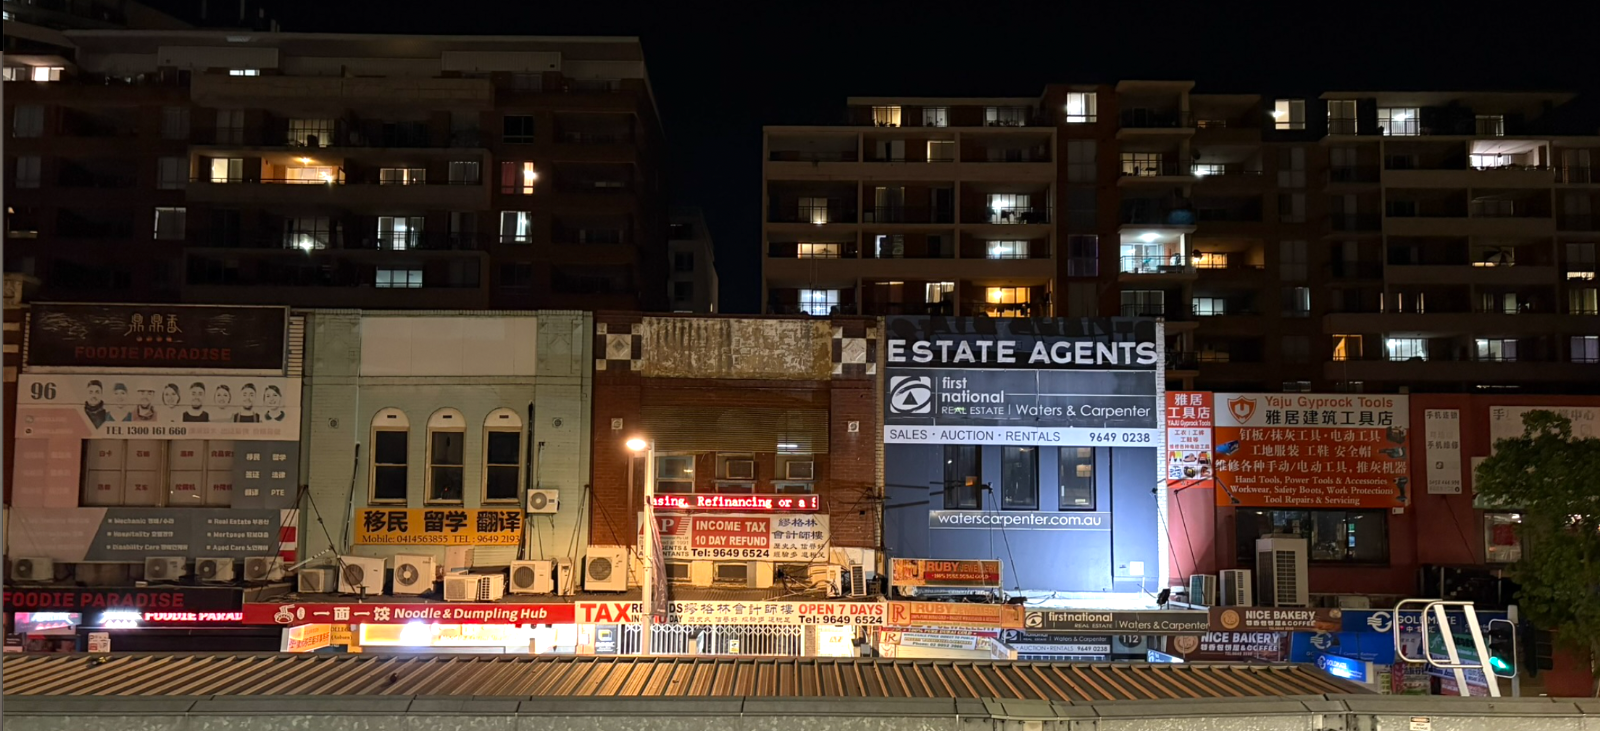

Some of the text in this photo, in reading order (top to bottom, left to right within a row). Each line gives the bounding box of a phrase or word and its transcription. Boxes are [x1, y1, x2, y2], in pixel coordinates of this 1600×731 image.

[74, 346, 231, 361] FOODIE PARADISE
[888, 339, 1158, 365] ESTATE AGENTS
[942, 376, 968, 390] first
[31, 382, 57, 400] 96
[942, 390, 1005, 404] national
[1174, 394, 1202, 406] 雅居
[1264, 396, 1394, 410] Yaju Gyprock Tools
[942, 404, 1151, 420] REAL ESTATE Waters & Carpenter
[1168, 407, 1210, 419] 工具店
[1266, 410, 1394, 426] 雅居建筑工具店
[106, 426, 123, 435] TEL
[128, 426, 149, 435] 1300
[152, 426, 166, 435] 161
[169, 426, 187, 435] 660
[889, 429, 1151, 444] SALES AUCTION RENTALS 9649 0238
[1250, 445, 1372, 458] 工地服装 工鞋 安全帽
[1235, 476, 1256, 484] Hand
[1259, 476, 1282, 485] Tools,
[1284, 476, 1309, 484] Power
[1345, 476, 1388, 484] Accessories
[1230, 486, 1272, 494] Workwear,
[1274, 486, 1298, 496] Safety
[1300, 486, 1324, 495] Boots,
[1350, 487, 1394, 495] Protections
[697, 496, 806, 508] Refinancing or a
[1264, 496, 1282, 504] Tool
[1285, 496, 1314, 505] Repairs
[1324, 496, 1360, 506] Servicing
[364, 511, 520, 532] 移民 留学 翻译
[938, 512, 1102, 527] waterscarpenter.com.au
[696, 520, 767, 532] INCOME TAX
[362, 535, 520, 543] Mobile: 0414563855 TEL 9649 2193
[695, 535, 768, 547] 10 DAY REFUND
[692, 549, 770, 558] Tel: 9649 6524
[926, 561, 960, 572] RUBY
[3, 592, 184, 608] FOODIE PARADISE
[394, 608, 441, 619] Noodle
[443, 608, 452, 618] &
[454, 608, 518, 622] Dumpling
[521, 608, 548, 619] Hub
[580, 603, 683, 622] TAX REDS
[798, 604, 884, 615] OPEN 7 DAYS
[918, 604, 954, 614] RUBY
[1246, 610, 1316, 620] NICE BAKERY
[198, 612, 243, 621] PARAD
[798, 616, 883, 624] Tel: 9649 6524
[1048, 611, 1113, 622] firstnational
[1398, 616, 1457, 624] GOLMTE
[1118, 620, 1151, 630] Waters
[1153, 620, 1160, 629] &
[1161, 620, 1210, 630] Carpenter
[1200, 632, 1279, 644] NICE BAKERY
